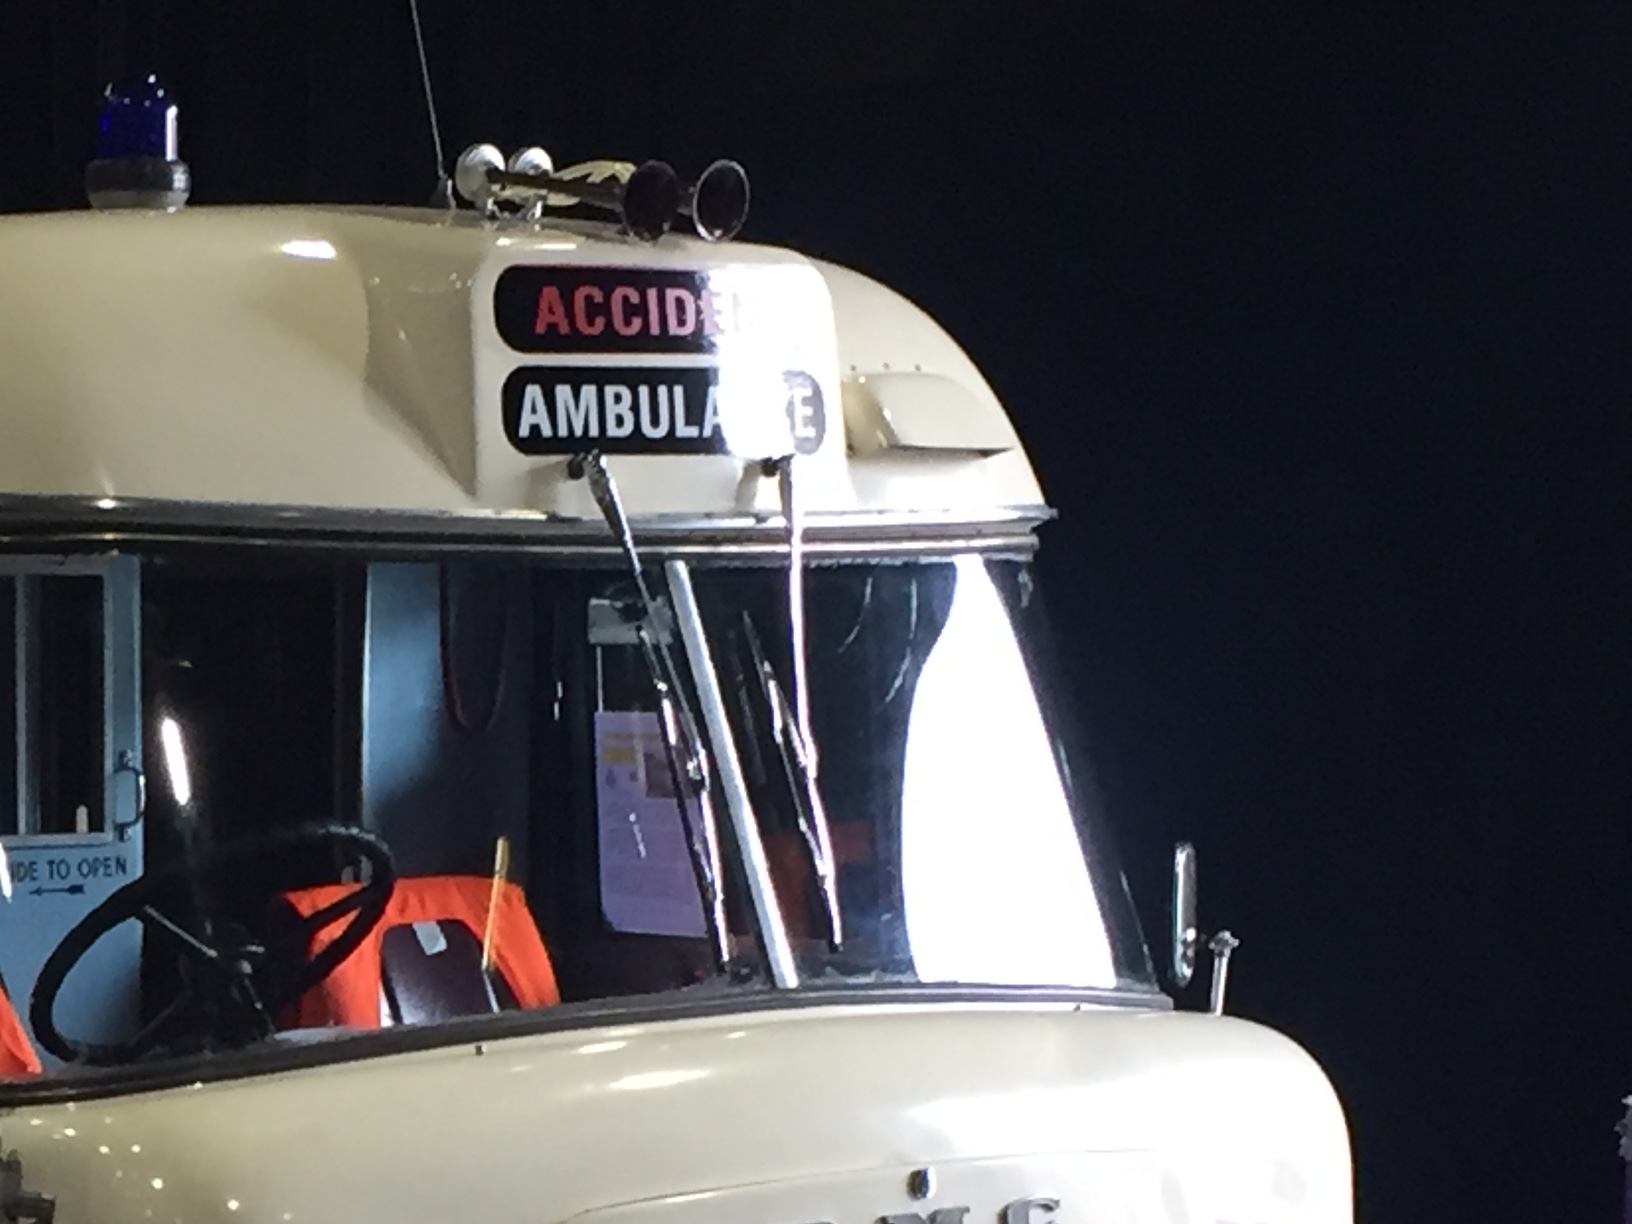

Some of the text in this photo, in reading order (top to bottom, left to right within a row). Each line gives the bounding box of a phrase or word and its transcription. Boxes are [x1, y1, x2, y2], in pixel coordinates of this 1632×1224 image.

[534, 284, 756, 337] ACCIDE
[518, 382, 818, 439] AMBULAE
[46, 858, 71, 881] TO
[77, 855, 127, 880] OPEN
